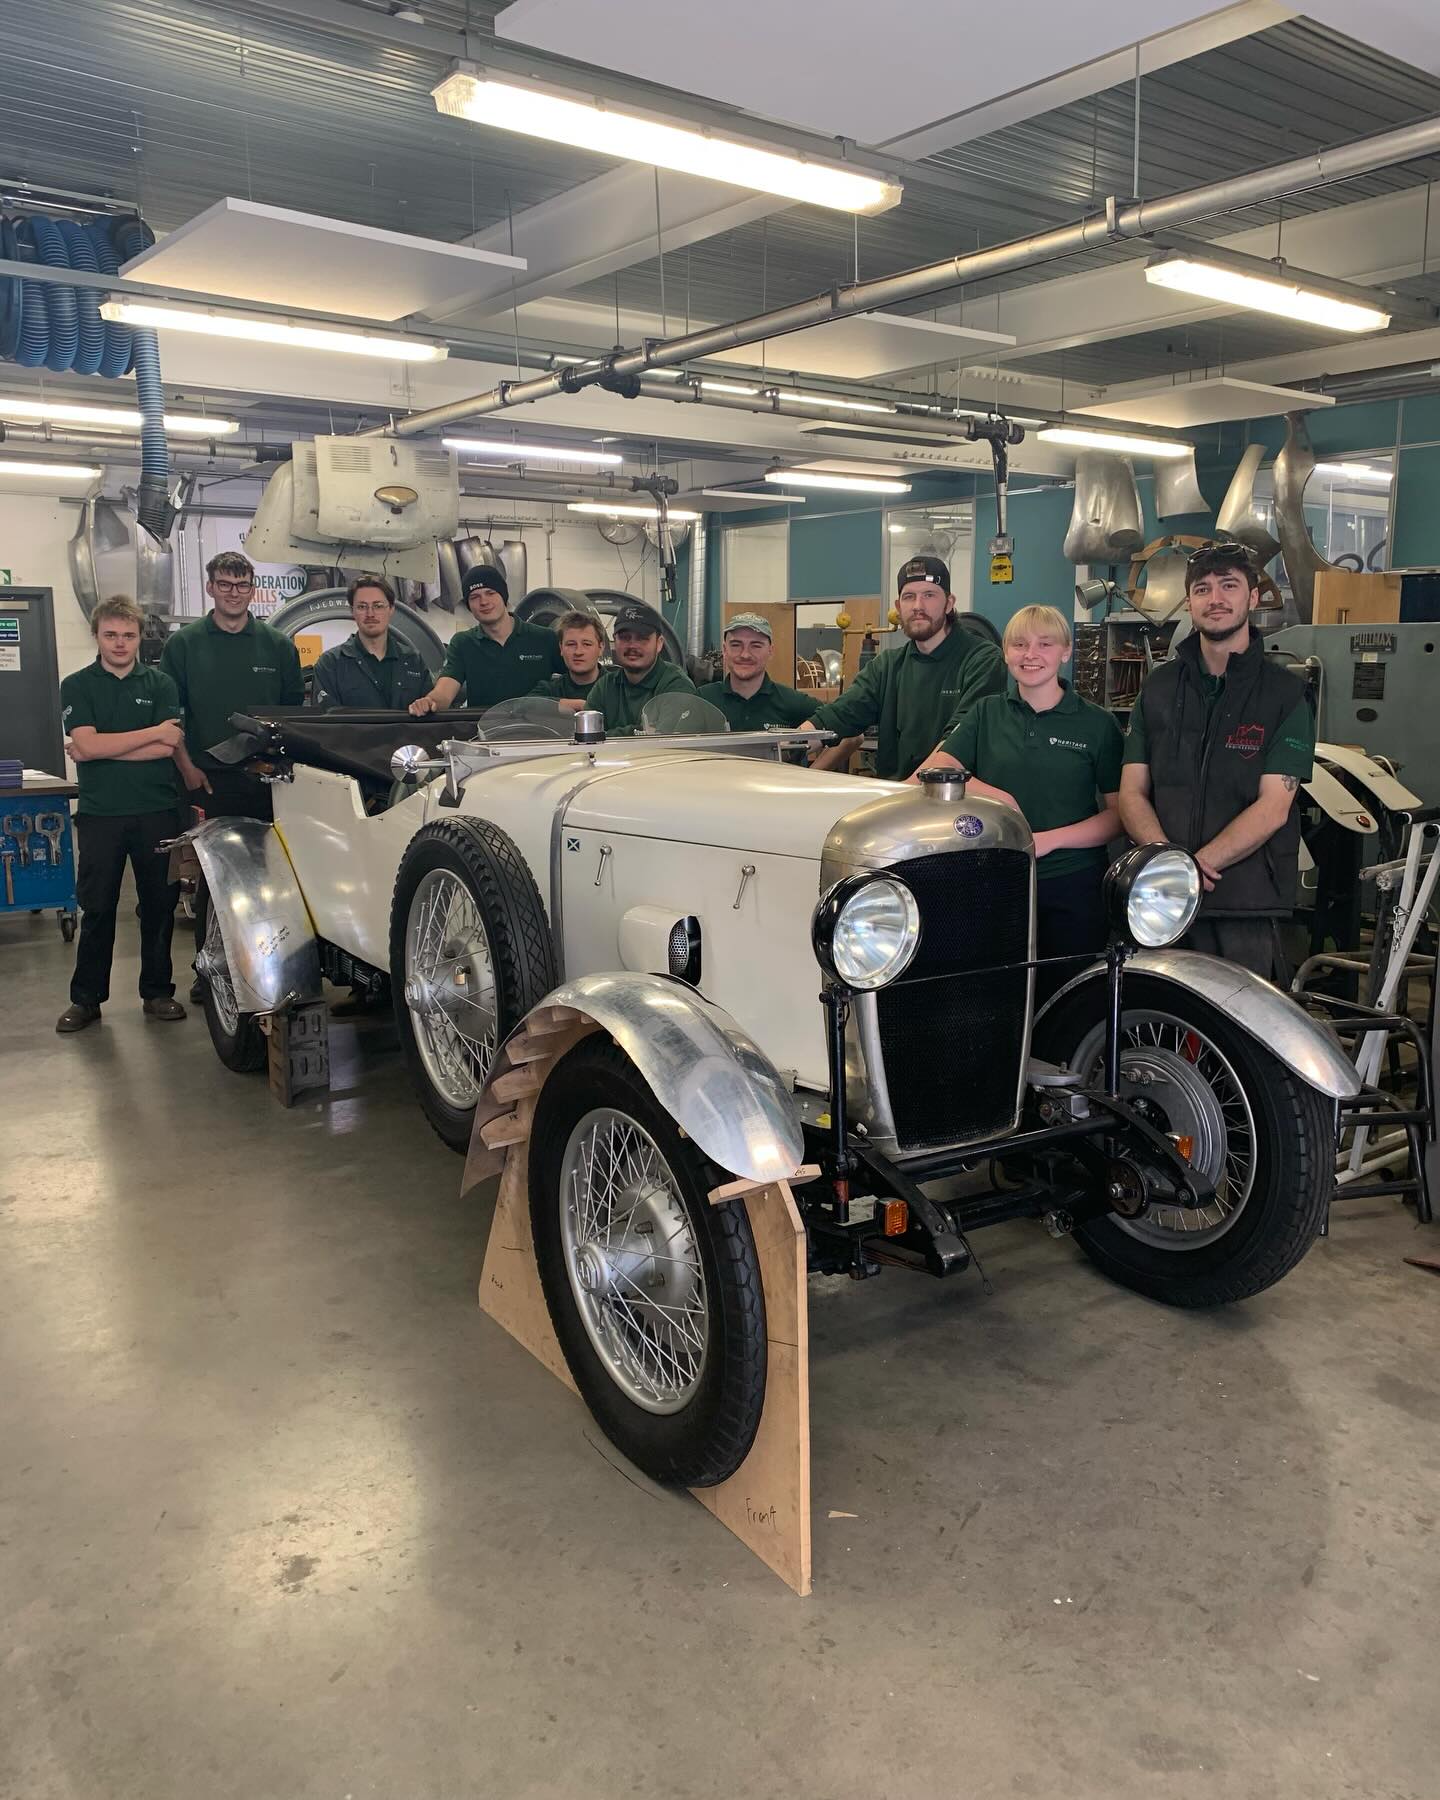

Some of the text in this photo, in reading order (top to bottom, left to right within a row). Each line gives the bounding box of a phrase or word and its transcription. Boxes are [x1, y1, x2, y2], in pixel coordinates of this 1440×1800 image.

[254, 575, 304, 590] DERATION
[252, 589, 277, 603] KILLS
[250, 604, 277, 617] RUST
[1354, 632, 1392, 646] PULLMAX
[1057, 740, 1087, 748] HERITAGE
[745, 1498, 782, 1536] Front
